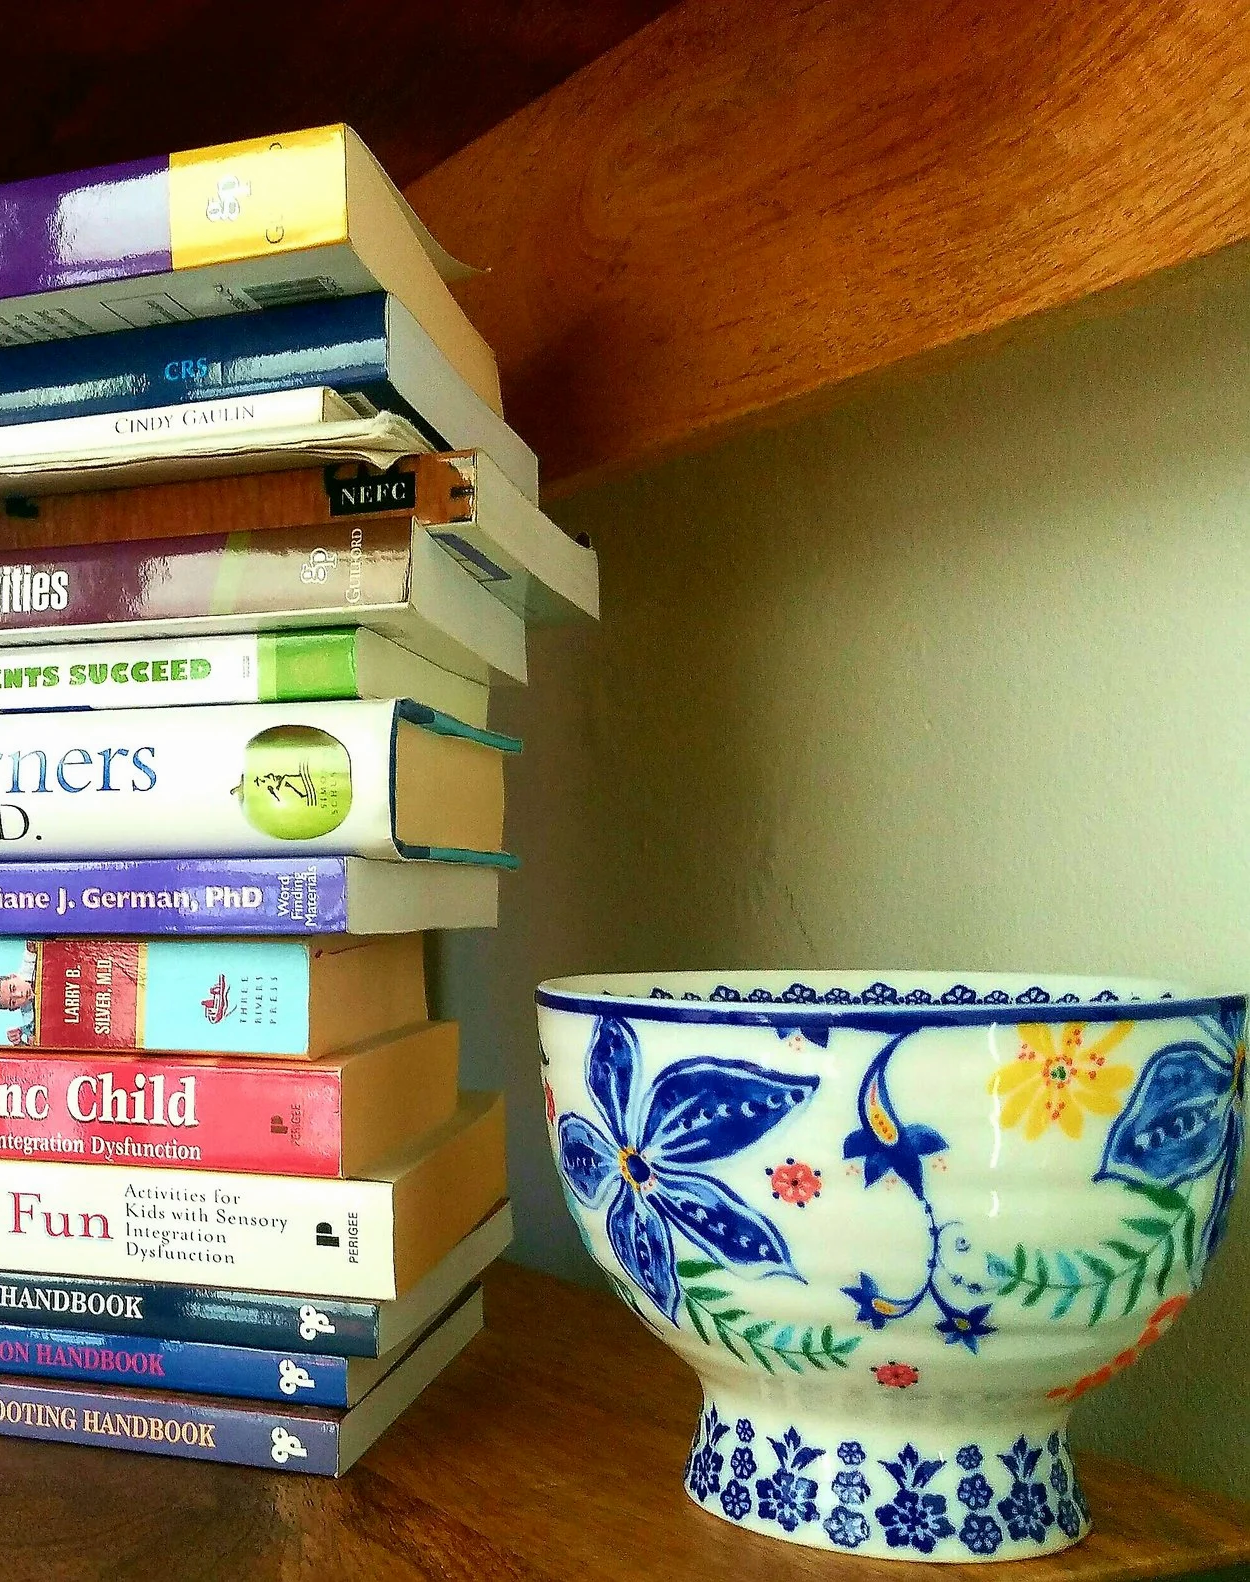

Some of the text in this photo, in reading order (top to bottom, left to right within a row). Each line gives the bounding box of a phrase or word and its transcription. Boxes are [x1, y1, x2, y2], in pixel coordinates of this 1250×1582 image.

[165, 358, 208, 382] CRS
[115, 413, 174, 435] CINDY
[69, 658, 212, 687] SUCCEED
[56, 888, 75, 915] J.
[82, 887, 198, 913] German,
[206, 886, 263, 909] PhD
[277, 875, 291, 917] Word
[291, 871, 305, 920] Finding
[305, 865, 318, 927] Materials
[64, 964, 82, 1025] LARRY B.
[95, 988, 112, 1035] SILVER,
[240, 976, 249, 1024] THREE
[255, 976, 263, 1024] RIVERS
[270, 976, 278, 1025] PRESS
[67, 1072, 200, 1128] Child
[91, 1136, 202, 1163] Dysfunction
[124, 1183, 241, 1205] Activities for
[7, 1191, 114, 1240] Fun
[125, 1203, 288, 1233] Kids with Sensory
[126, 1222, 227, 1245] Integration
[126, 1241, 235, 1264] Dysfunction
[348, 1212, 359, 1264] PERIGEE
[0, 1285, 143, 1319] HANDBOOK
[35, 1343, 166, 1377] HANDBOOK
[83, 1409, 216, 1449] HANDBOOK
